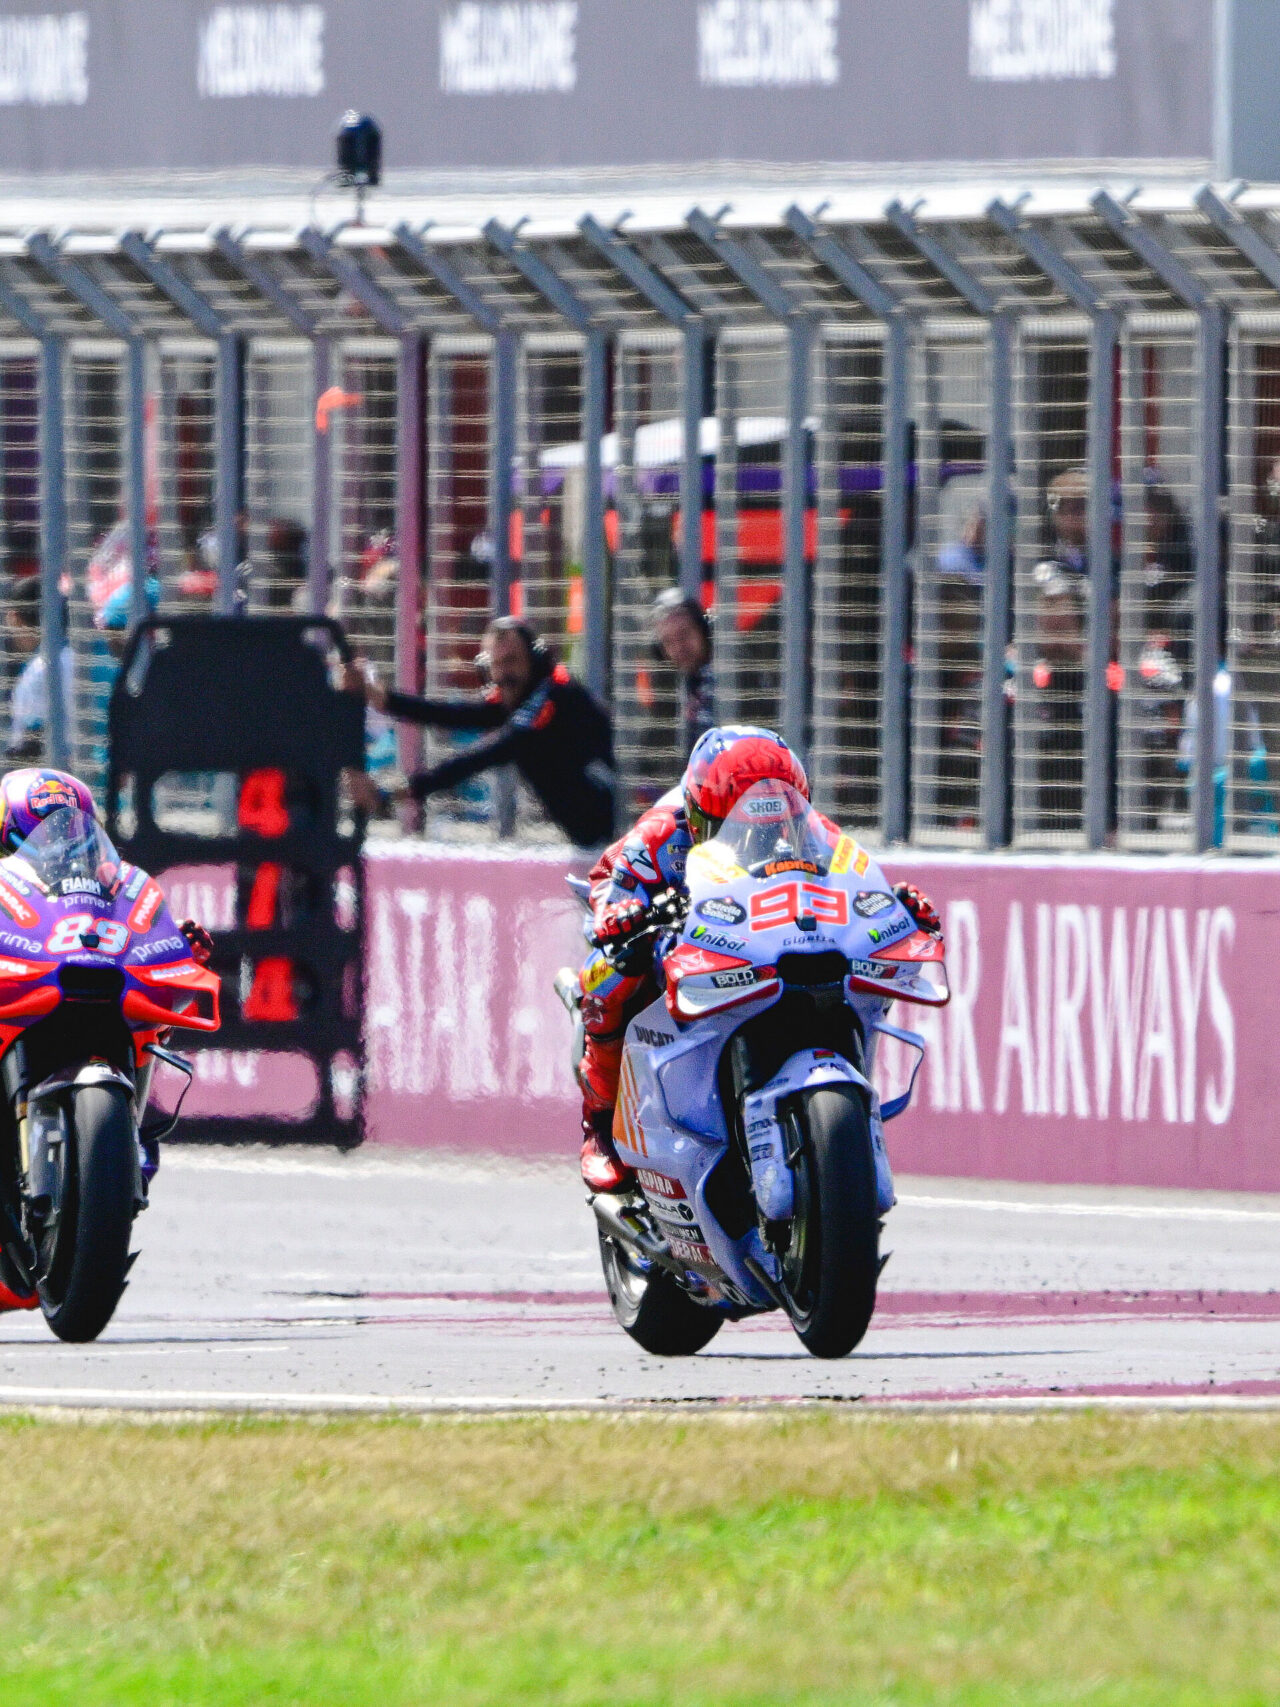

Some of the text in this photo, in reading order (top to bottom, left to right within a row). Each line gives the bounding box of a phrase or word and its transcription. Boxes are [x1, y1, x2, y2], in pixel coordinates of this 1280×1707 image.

[748, 801, 782, 814] SHOEI
[61, 877, 100, 894] FIAMM
[63, 895, 106, 909] prima
[751, 882, 847, 931] 93
[47, 915, 128, 954] 89
[689, 925, 747, 951] Unibat
[868, 918, 910, 944] Unibat
[131, 936, 184, 963] prima
[716, 969, 754, 984] BOLD
[994, 899, 1236, 1125] AIRWAYS
